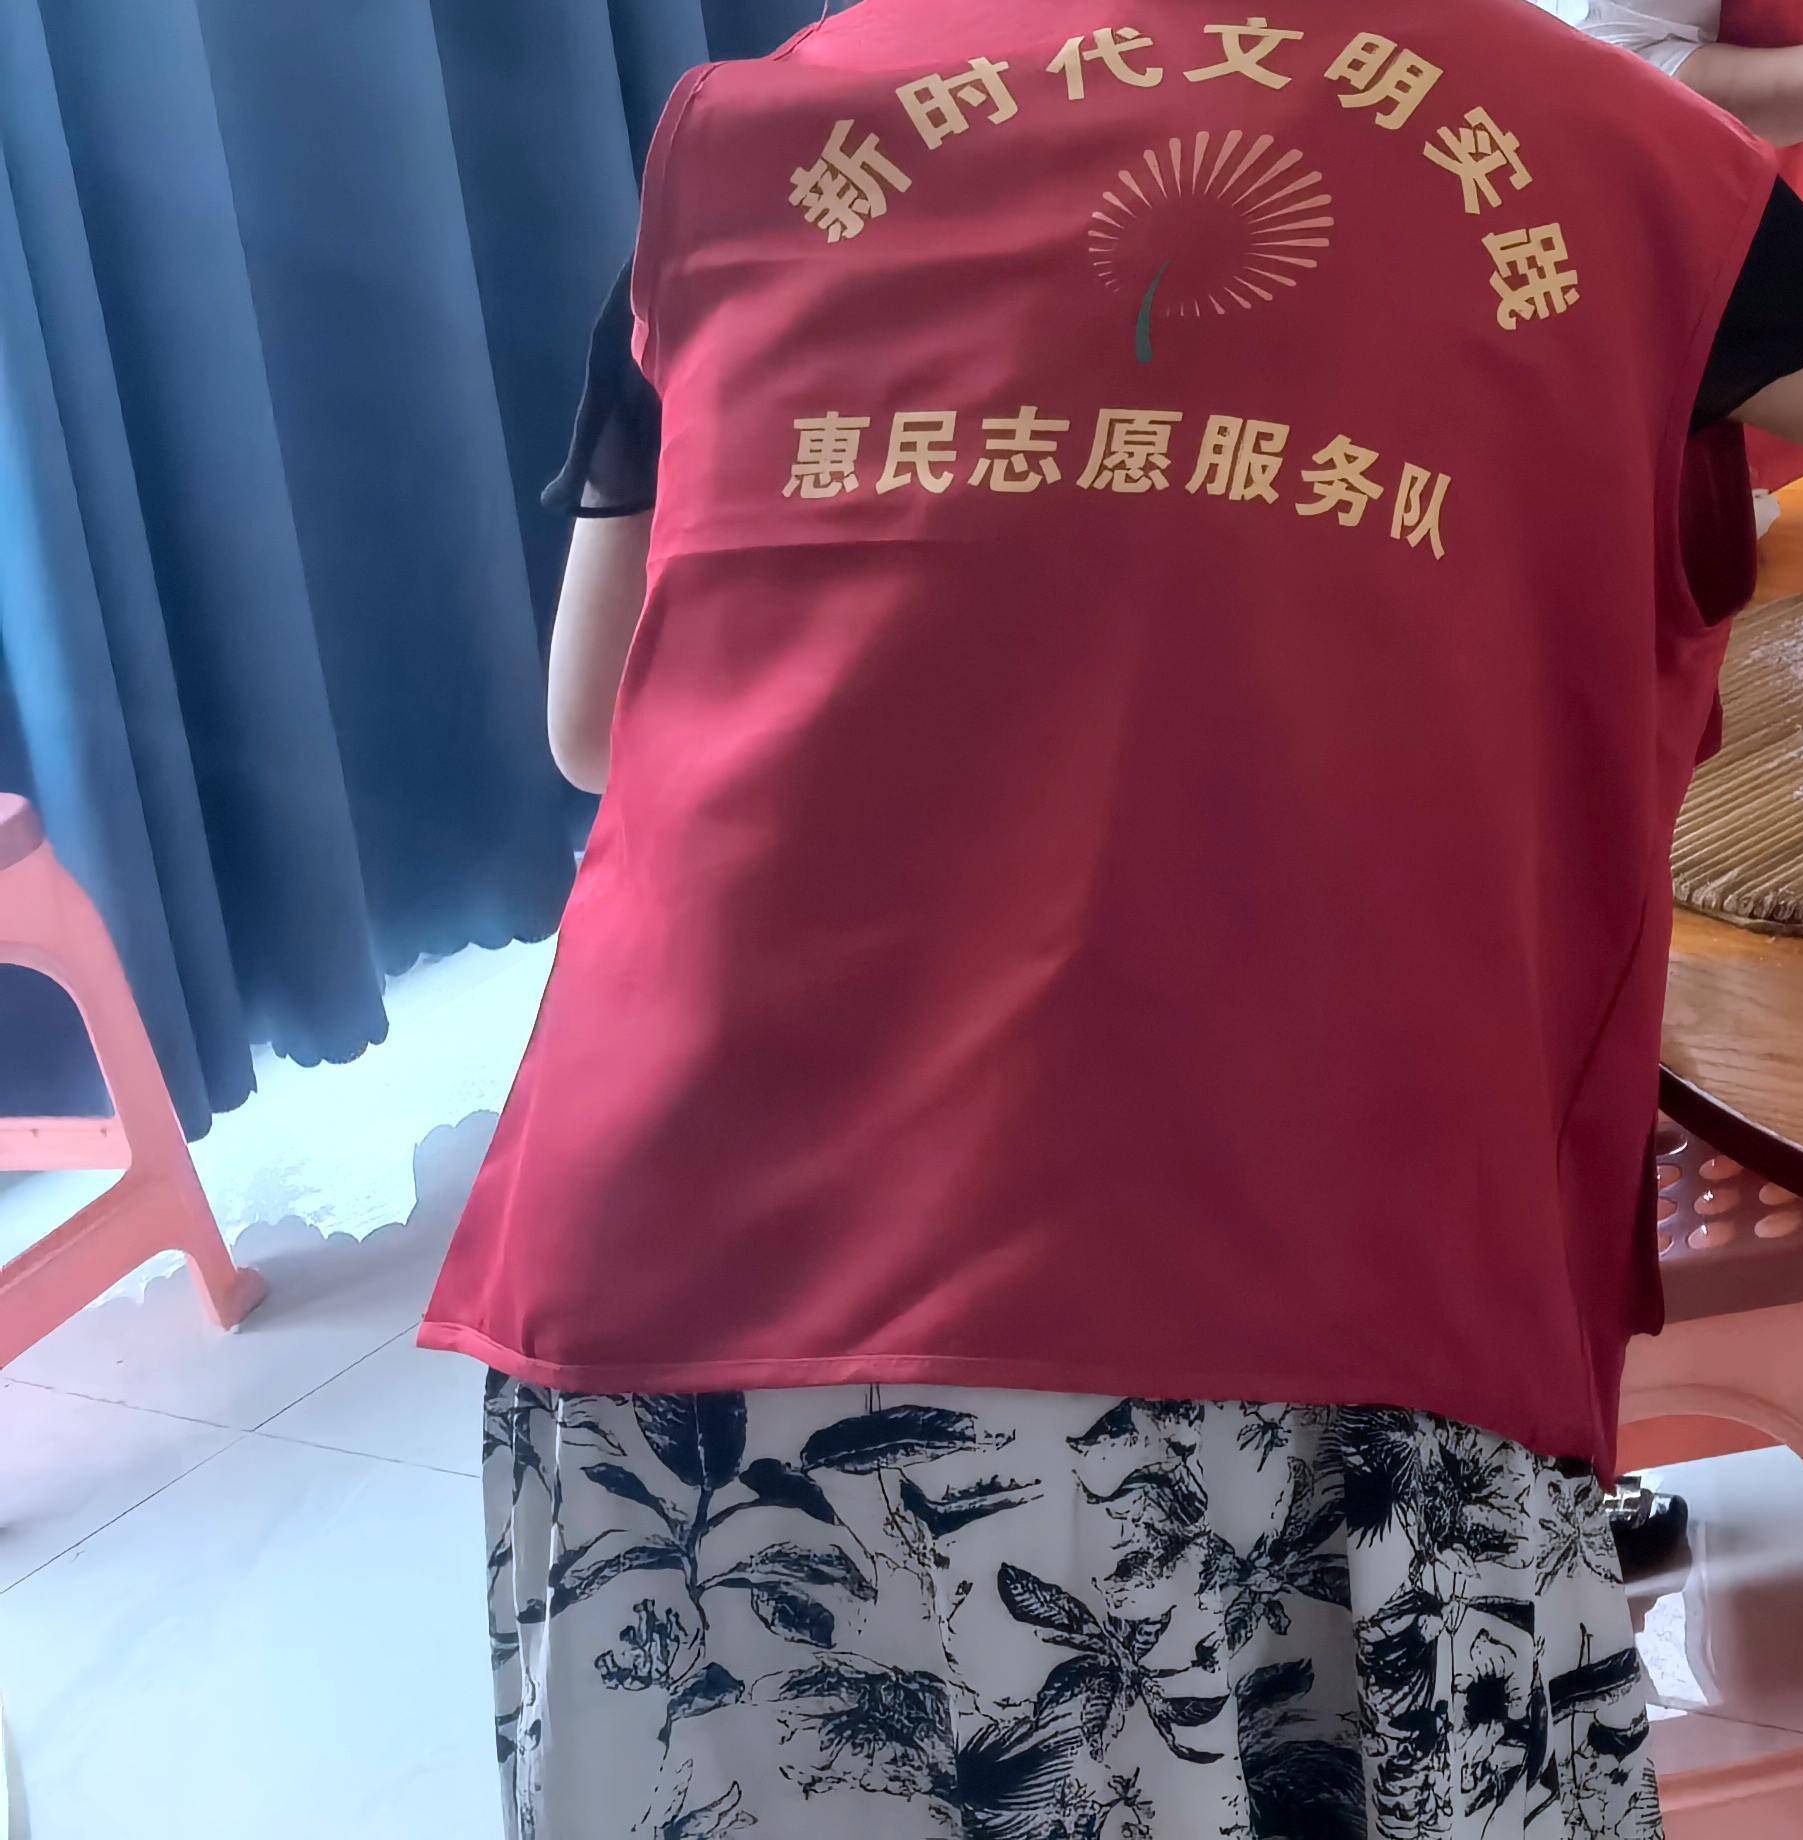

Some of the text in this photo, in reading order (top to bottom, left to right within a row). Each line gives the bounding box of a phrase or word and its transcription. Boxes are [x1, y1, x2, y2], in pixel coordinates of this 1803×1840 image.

[787, 16, 1580, 332] 新时代文明实践
[781, 406, 1457, 560] 惠民志愿服务队
